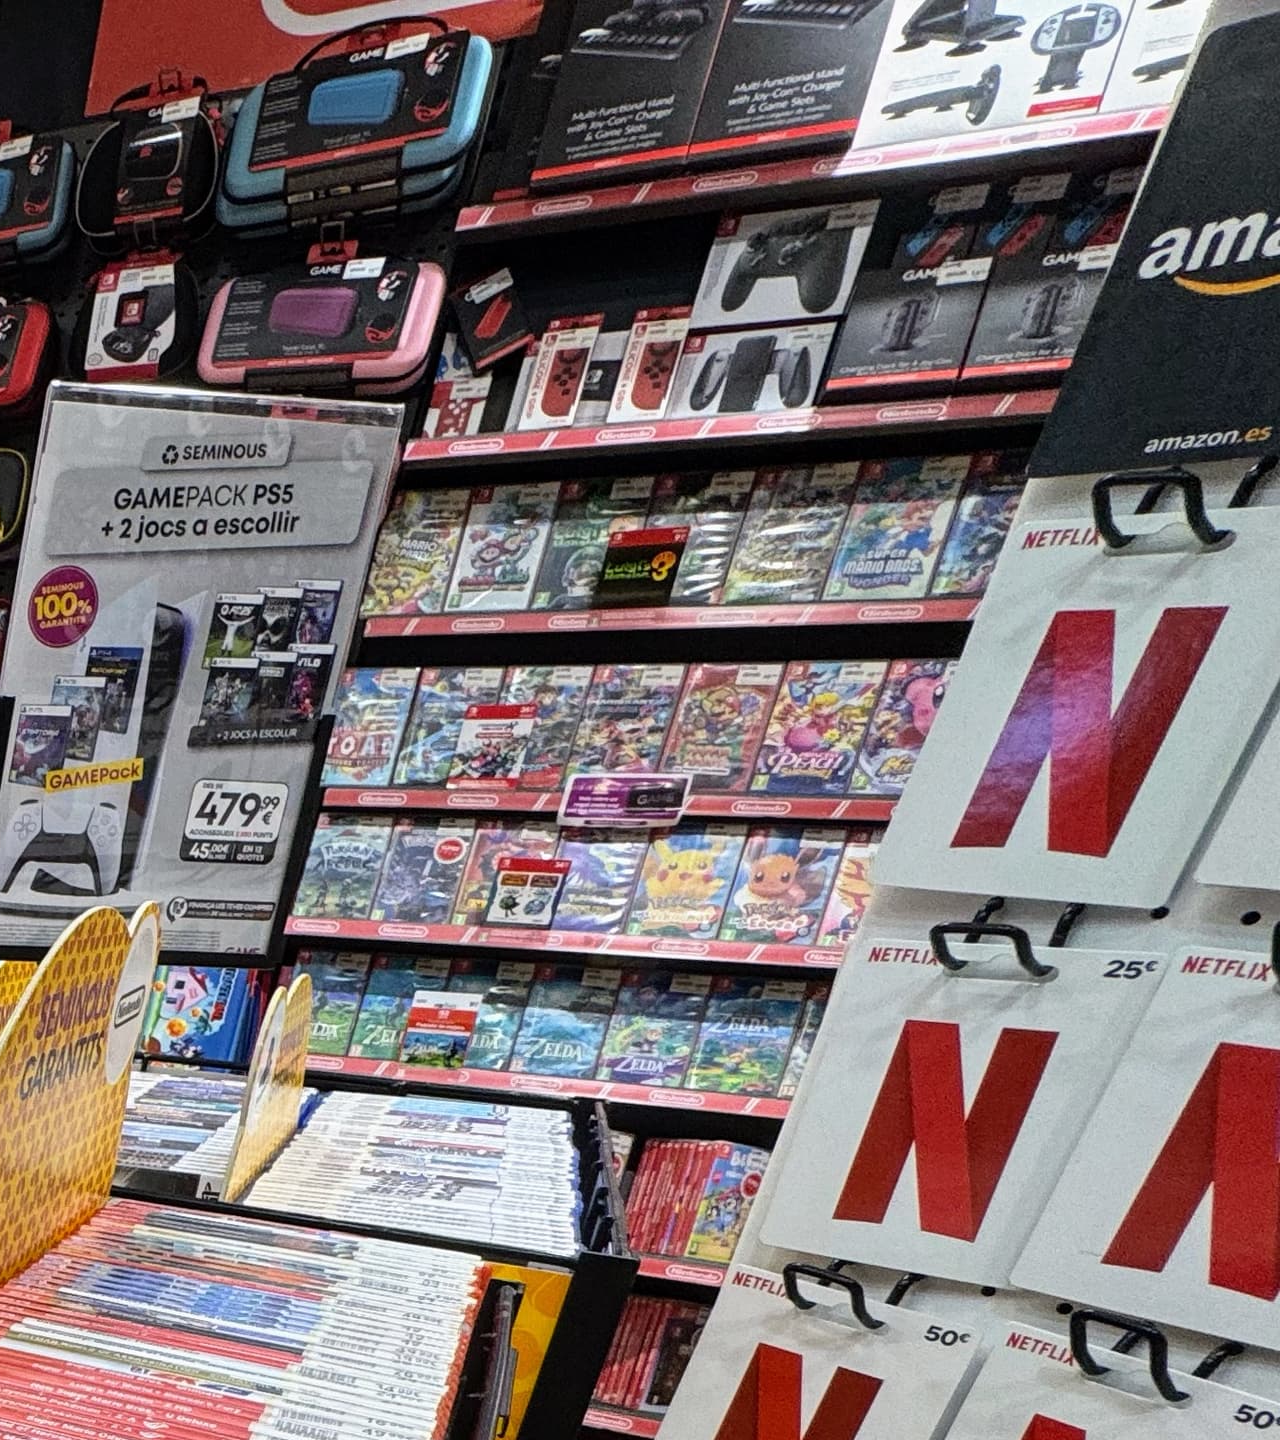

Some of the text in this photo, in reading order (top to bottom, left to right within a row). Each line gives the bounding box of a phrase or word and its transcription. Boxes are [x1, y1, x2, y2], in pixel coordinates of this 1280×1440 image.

[182, 443, 268, 461] SEMINOUS
[1144, 425, 1272, 454] amazon.es
[114, 483, 294, 510] GAMEPACK PS5
[119, 518, 132, 539] 2
[134, 514, 187, 543] jocs
[192, 520, 208, 537] a
[214, 510, 300, 535] escollir
[1023, 527, 1101, 550] NETFLIX
[33, 592, 92, 620] 100%
[49, 763, 141, 790] GAMEPack
[1104, 959, 1158, 979] 25€
[1182, 956, 1272, 982] NETFLIX
[33, 977, 111, 1042] SEMINOUS
[17, 1030, 106, 1101] GARANTITS
[924, 1325, 971, 1346] 50€
